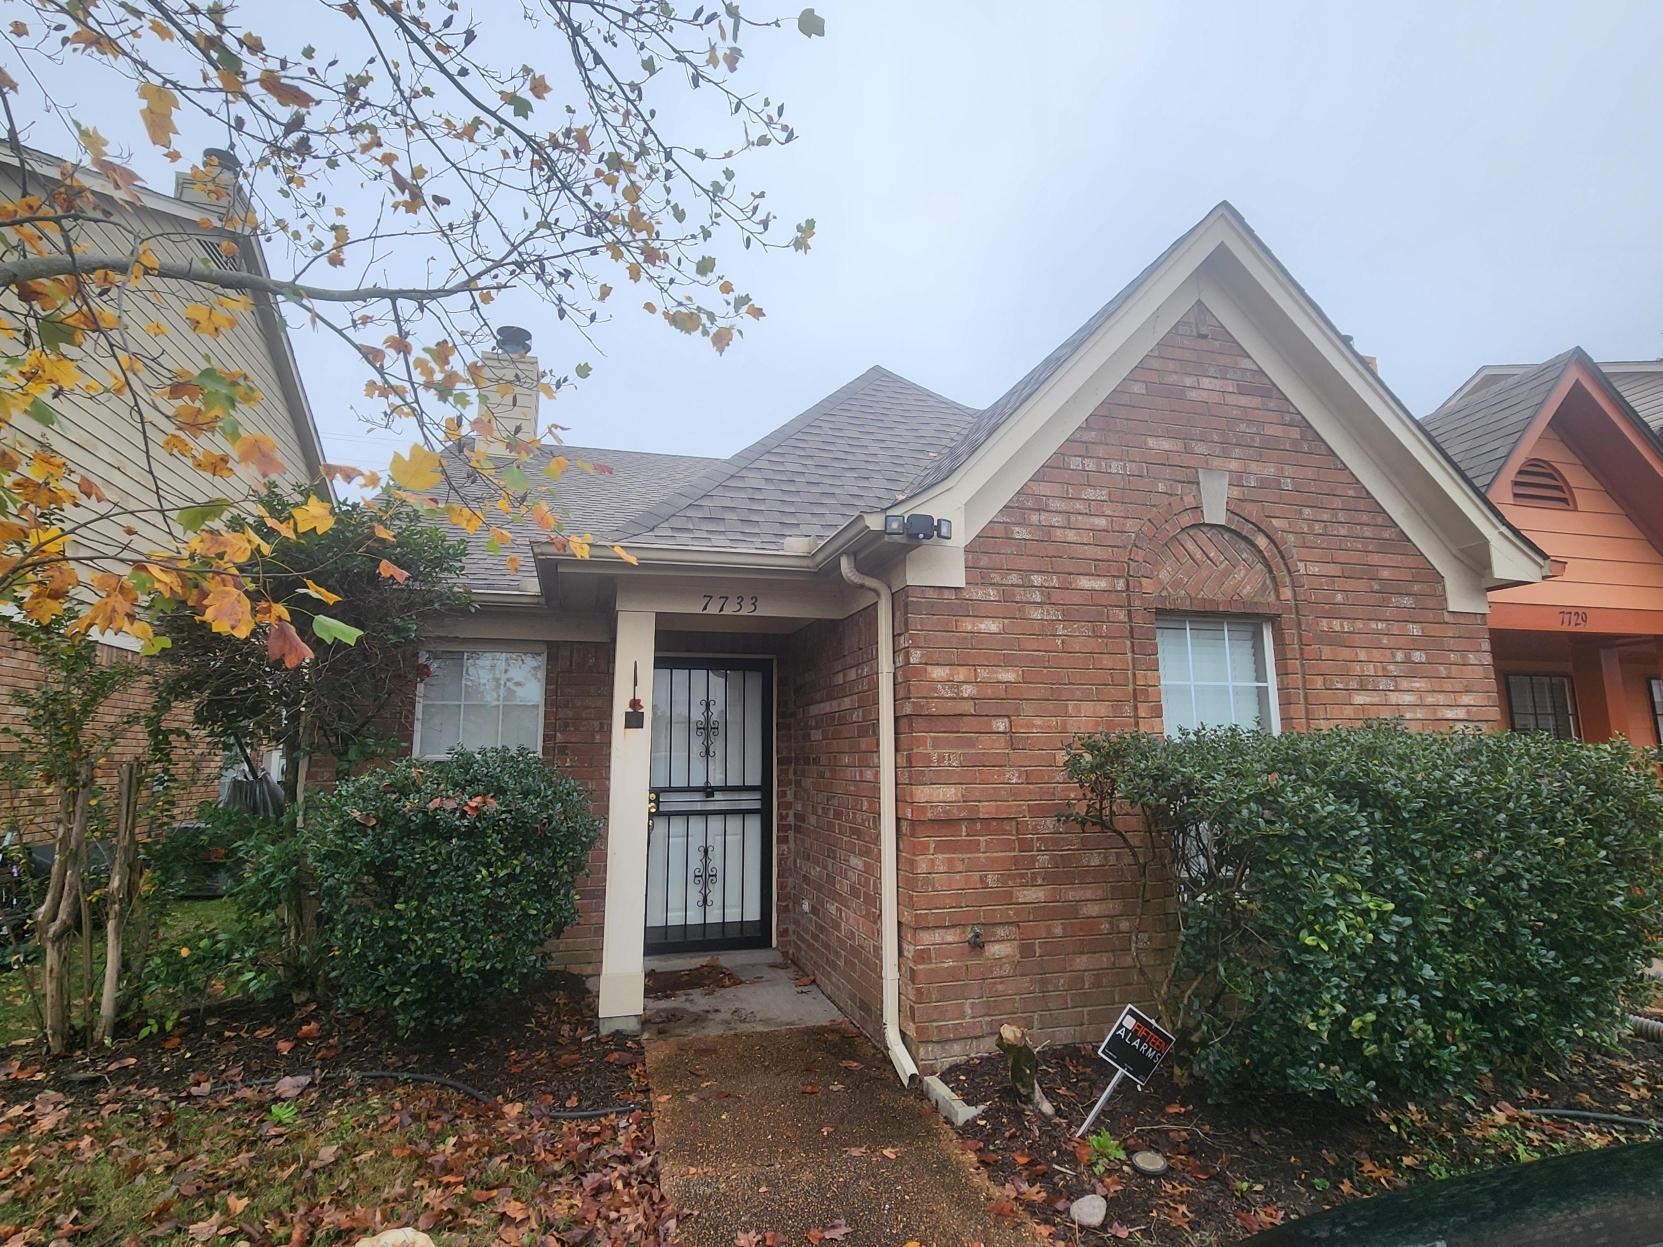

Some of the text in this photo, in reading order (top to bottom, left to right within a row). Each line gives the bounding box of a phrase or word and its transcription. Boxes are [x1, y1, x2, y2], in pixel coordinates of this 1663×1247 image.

[701, 594, 759, 614] 7733
[1558, 610, 1588, 627] 7729
[1115, 1027, 1162, 1064] ALARMS
[1131, 1022, 1168, 1054] FIFTEEN
